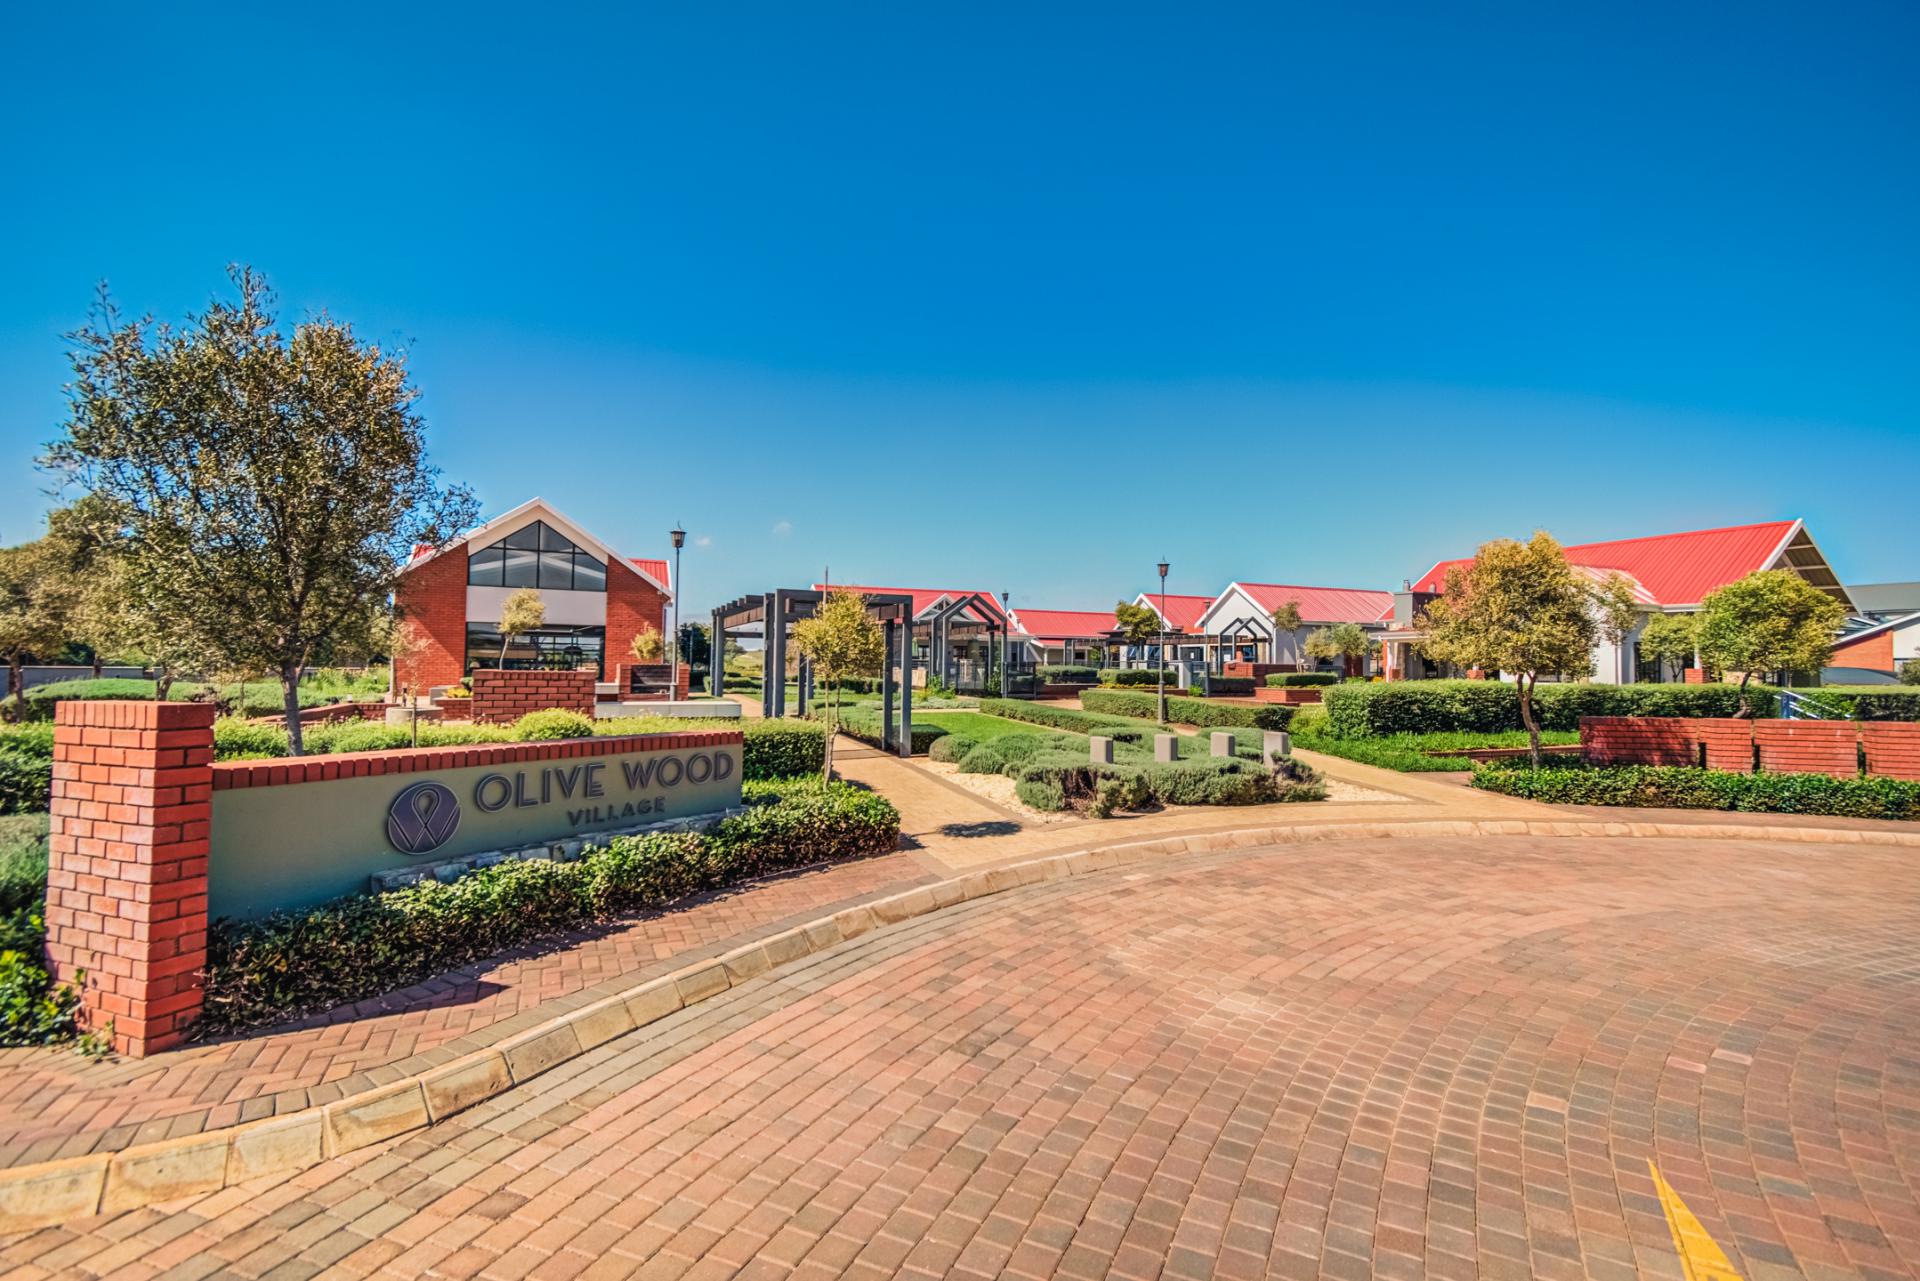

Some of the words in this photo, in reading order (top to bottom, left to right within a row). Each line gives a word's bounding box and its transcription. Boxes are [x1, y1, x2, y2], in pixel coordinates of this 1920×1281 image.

[475, 763, 607, 813] OLIVE
[623, 752, 733, 791] WOOD
[568, 797, 666, 827] VILLAGE
